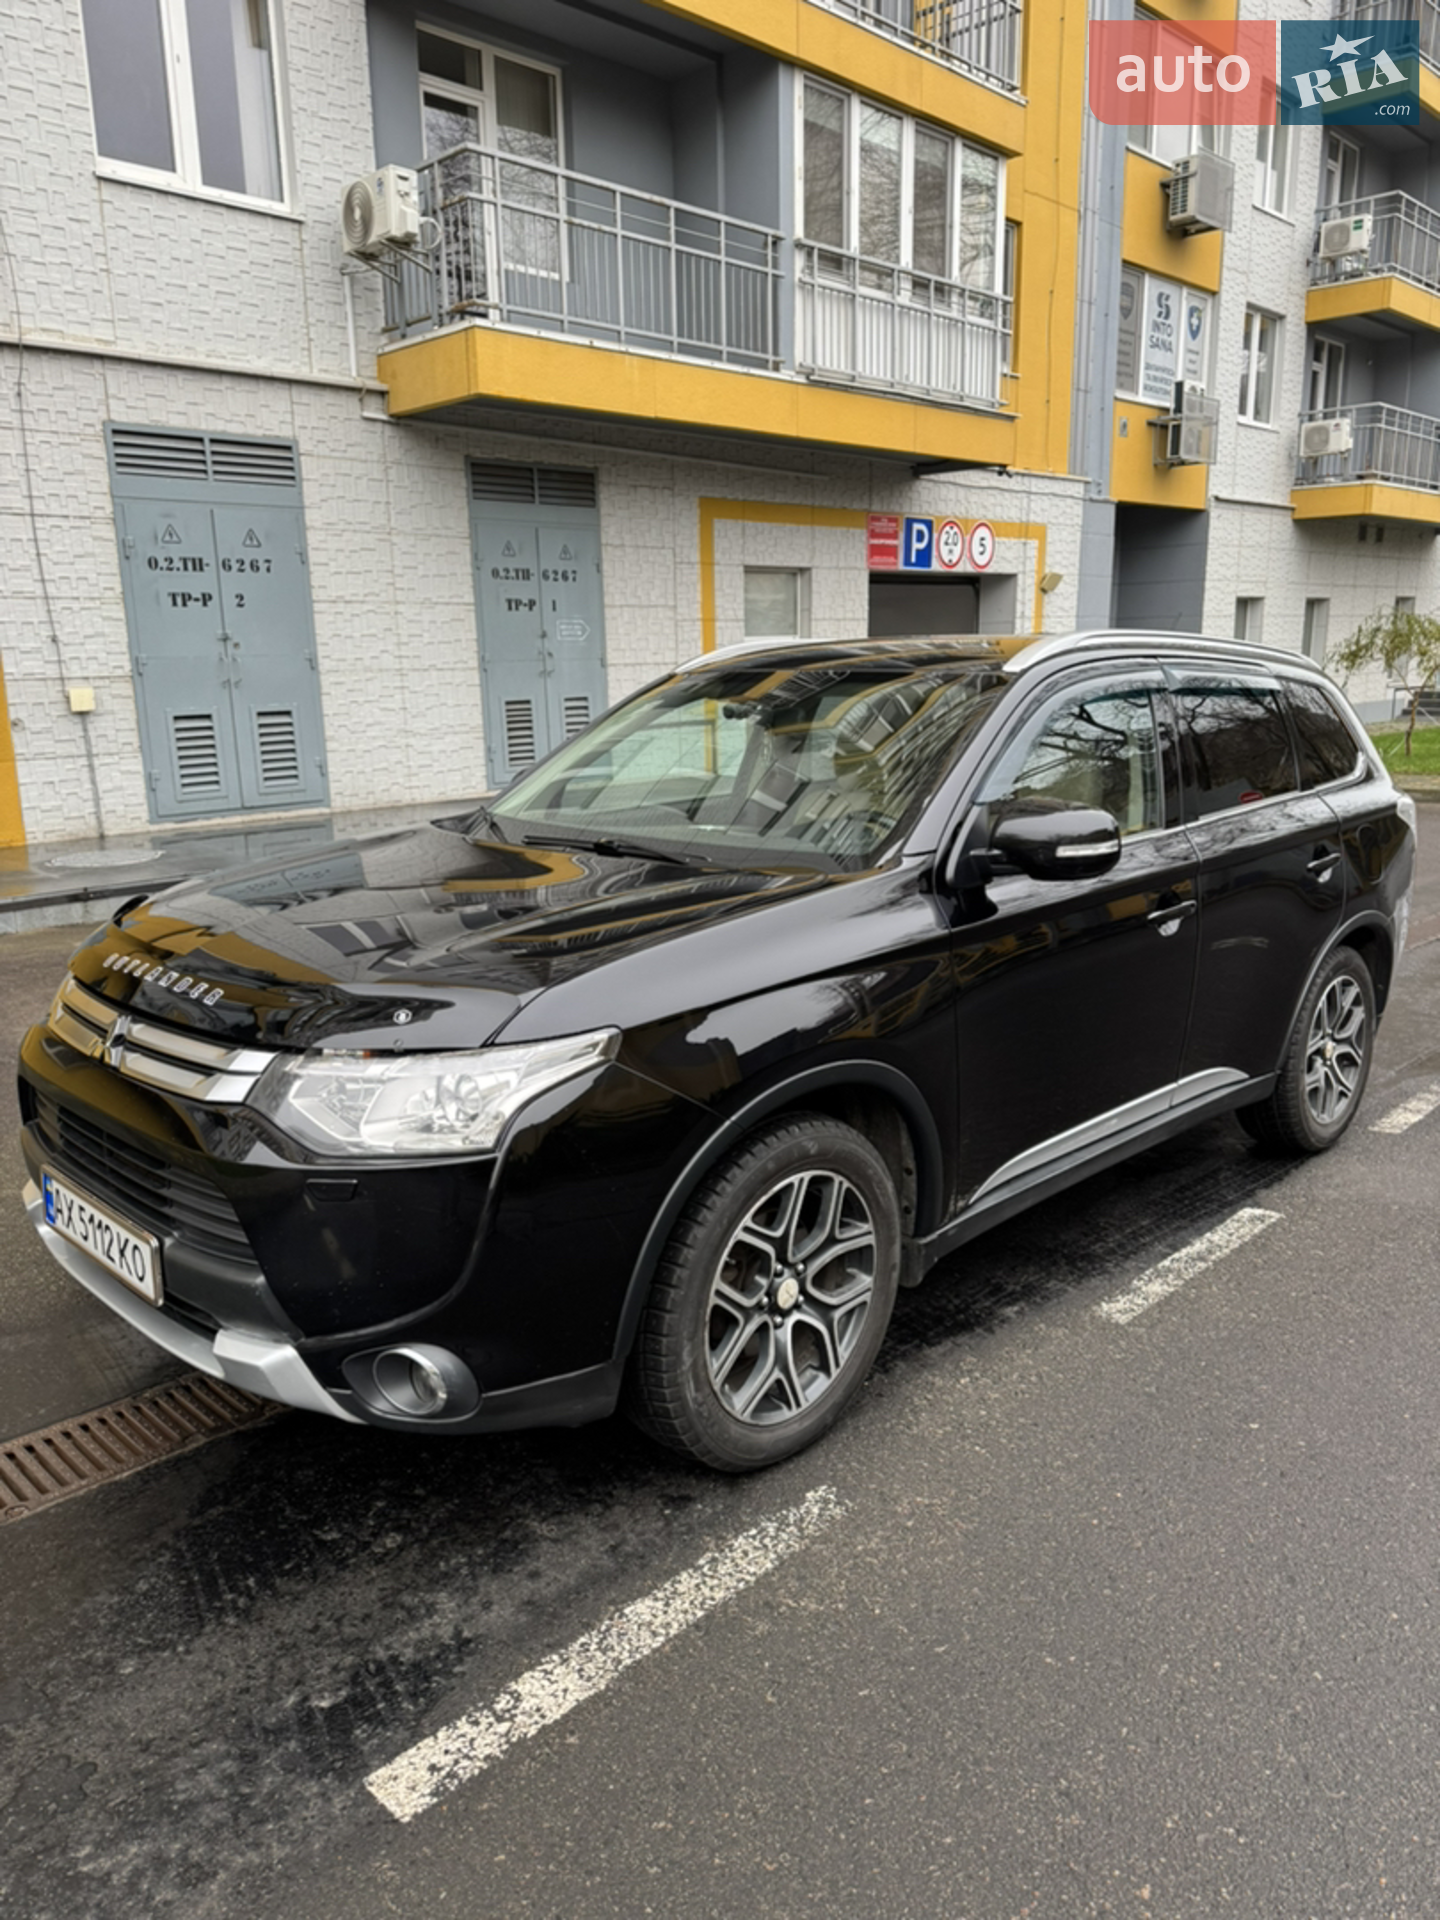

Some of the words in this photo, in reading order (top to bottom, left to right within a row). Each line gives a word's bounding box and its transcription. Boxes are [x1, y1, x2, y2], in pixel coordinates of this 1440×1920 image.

[1152, 319, 1173, 338] INTO
[1149, 334, 1173, 354] SANA
[910, 522, 929, 563] P
[978, 537, 986, 555] 5
[221, 558, 272, 573] 6267
[541, 569, 577, 582] 6267
[234, 593, 245, 608] 2
[103, 953, 224, 1006] OUTLANDER
